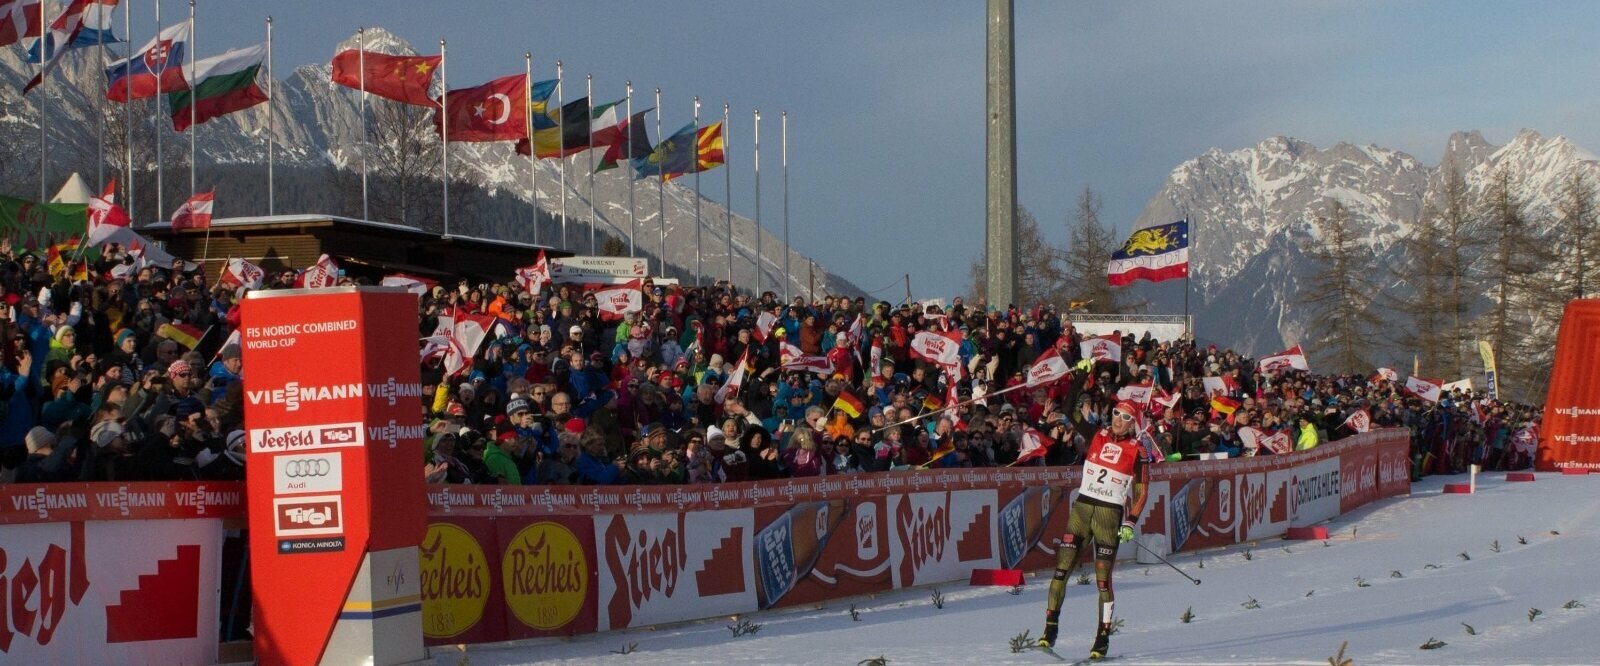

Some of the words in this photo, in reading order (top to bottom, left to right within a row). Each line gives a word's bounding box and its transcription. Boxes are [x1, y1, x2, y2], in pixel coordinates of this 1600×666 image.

[247, 328, 260, 337] FIS
[263, 324, 301, 336] NORDIC
[303, 320, 357, 333] COMBINED
[247, 339, 278, 349] WORLD
[279, 338, 296, 347] CUP
[247, 381, 363, 412] VIESSMANN
[367, 377, 422, 406] VIESSMANN
[259, 430, 313, 450] Seefeld
[324, 430, 353, 441] Tirol
[368, 420, 425, 448] VIESSMANN
[1087, 483, 1113, 497] Seefeld
[1096, 468, 1108, 484] 2
[12, 488, 87, 519] VIESSMANN
[96, 486, 165, 516] VIESSMANN
[175, 486, 240, 515] VIESSMANN
[428, 488, 475, 512] VIESSMANN
[480, 489, 525, 512] VIESSMANN
[531, 489, 575, 512] VIESSMANN
[580, 489, 620, 512] VIESSMANN
[1240, 471, 1267, 541] Stiegl
[285, 506, 332, 525] Tirol
[774, 525, 791, 579] Sport
[896, 491, 951, 588] Stiegl
[420, 547, 482, 600] echeis
[511, 544, 581, 596] Recheis
[604, 512, 687, 629] Stiegl
[0, 521, 90, 653] iegl
